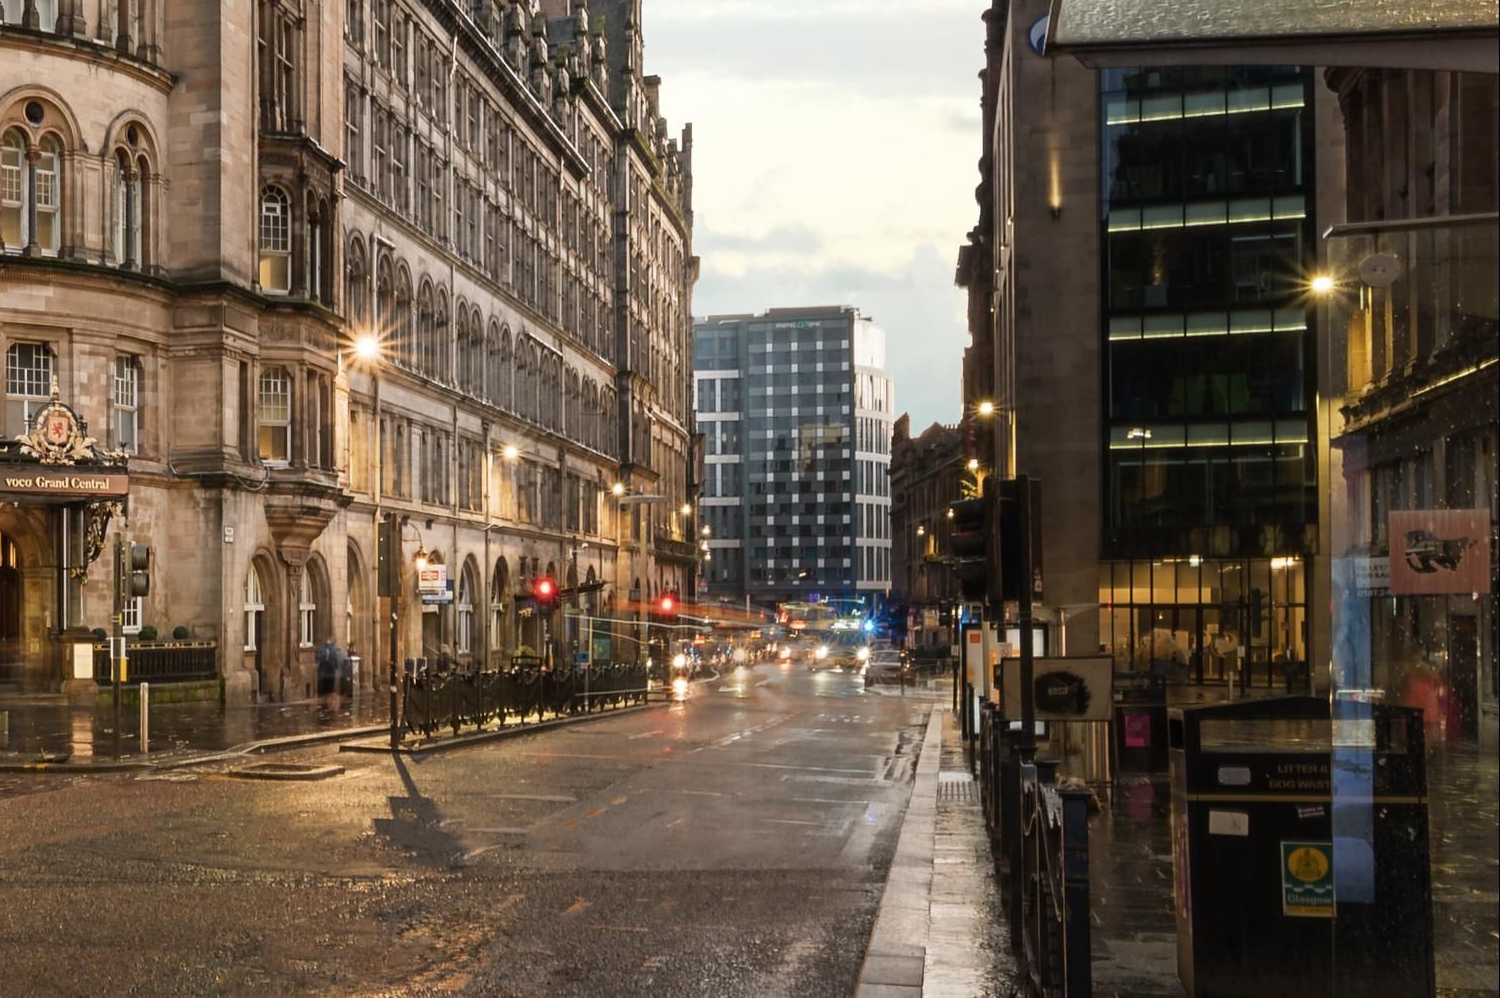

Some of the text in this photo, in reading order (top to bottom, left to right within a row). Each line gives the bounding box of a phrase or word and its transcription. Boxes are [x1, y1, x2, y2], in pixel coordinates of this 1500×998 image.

[6, 477, 110, 490] voco Grand Central
[1277, 764, 1317, 773] LITTER
[1269, 780, 1331, 789] DOG WAST
[1287, 893, 1332, 906] Glasgow
